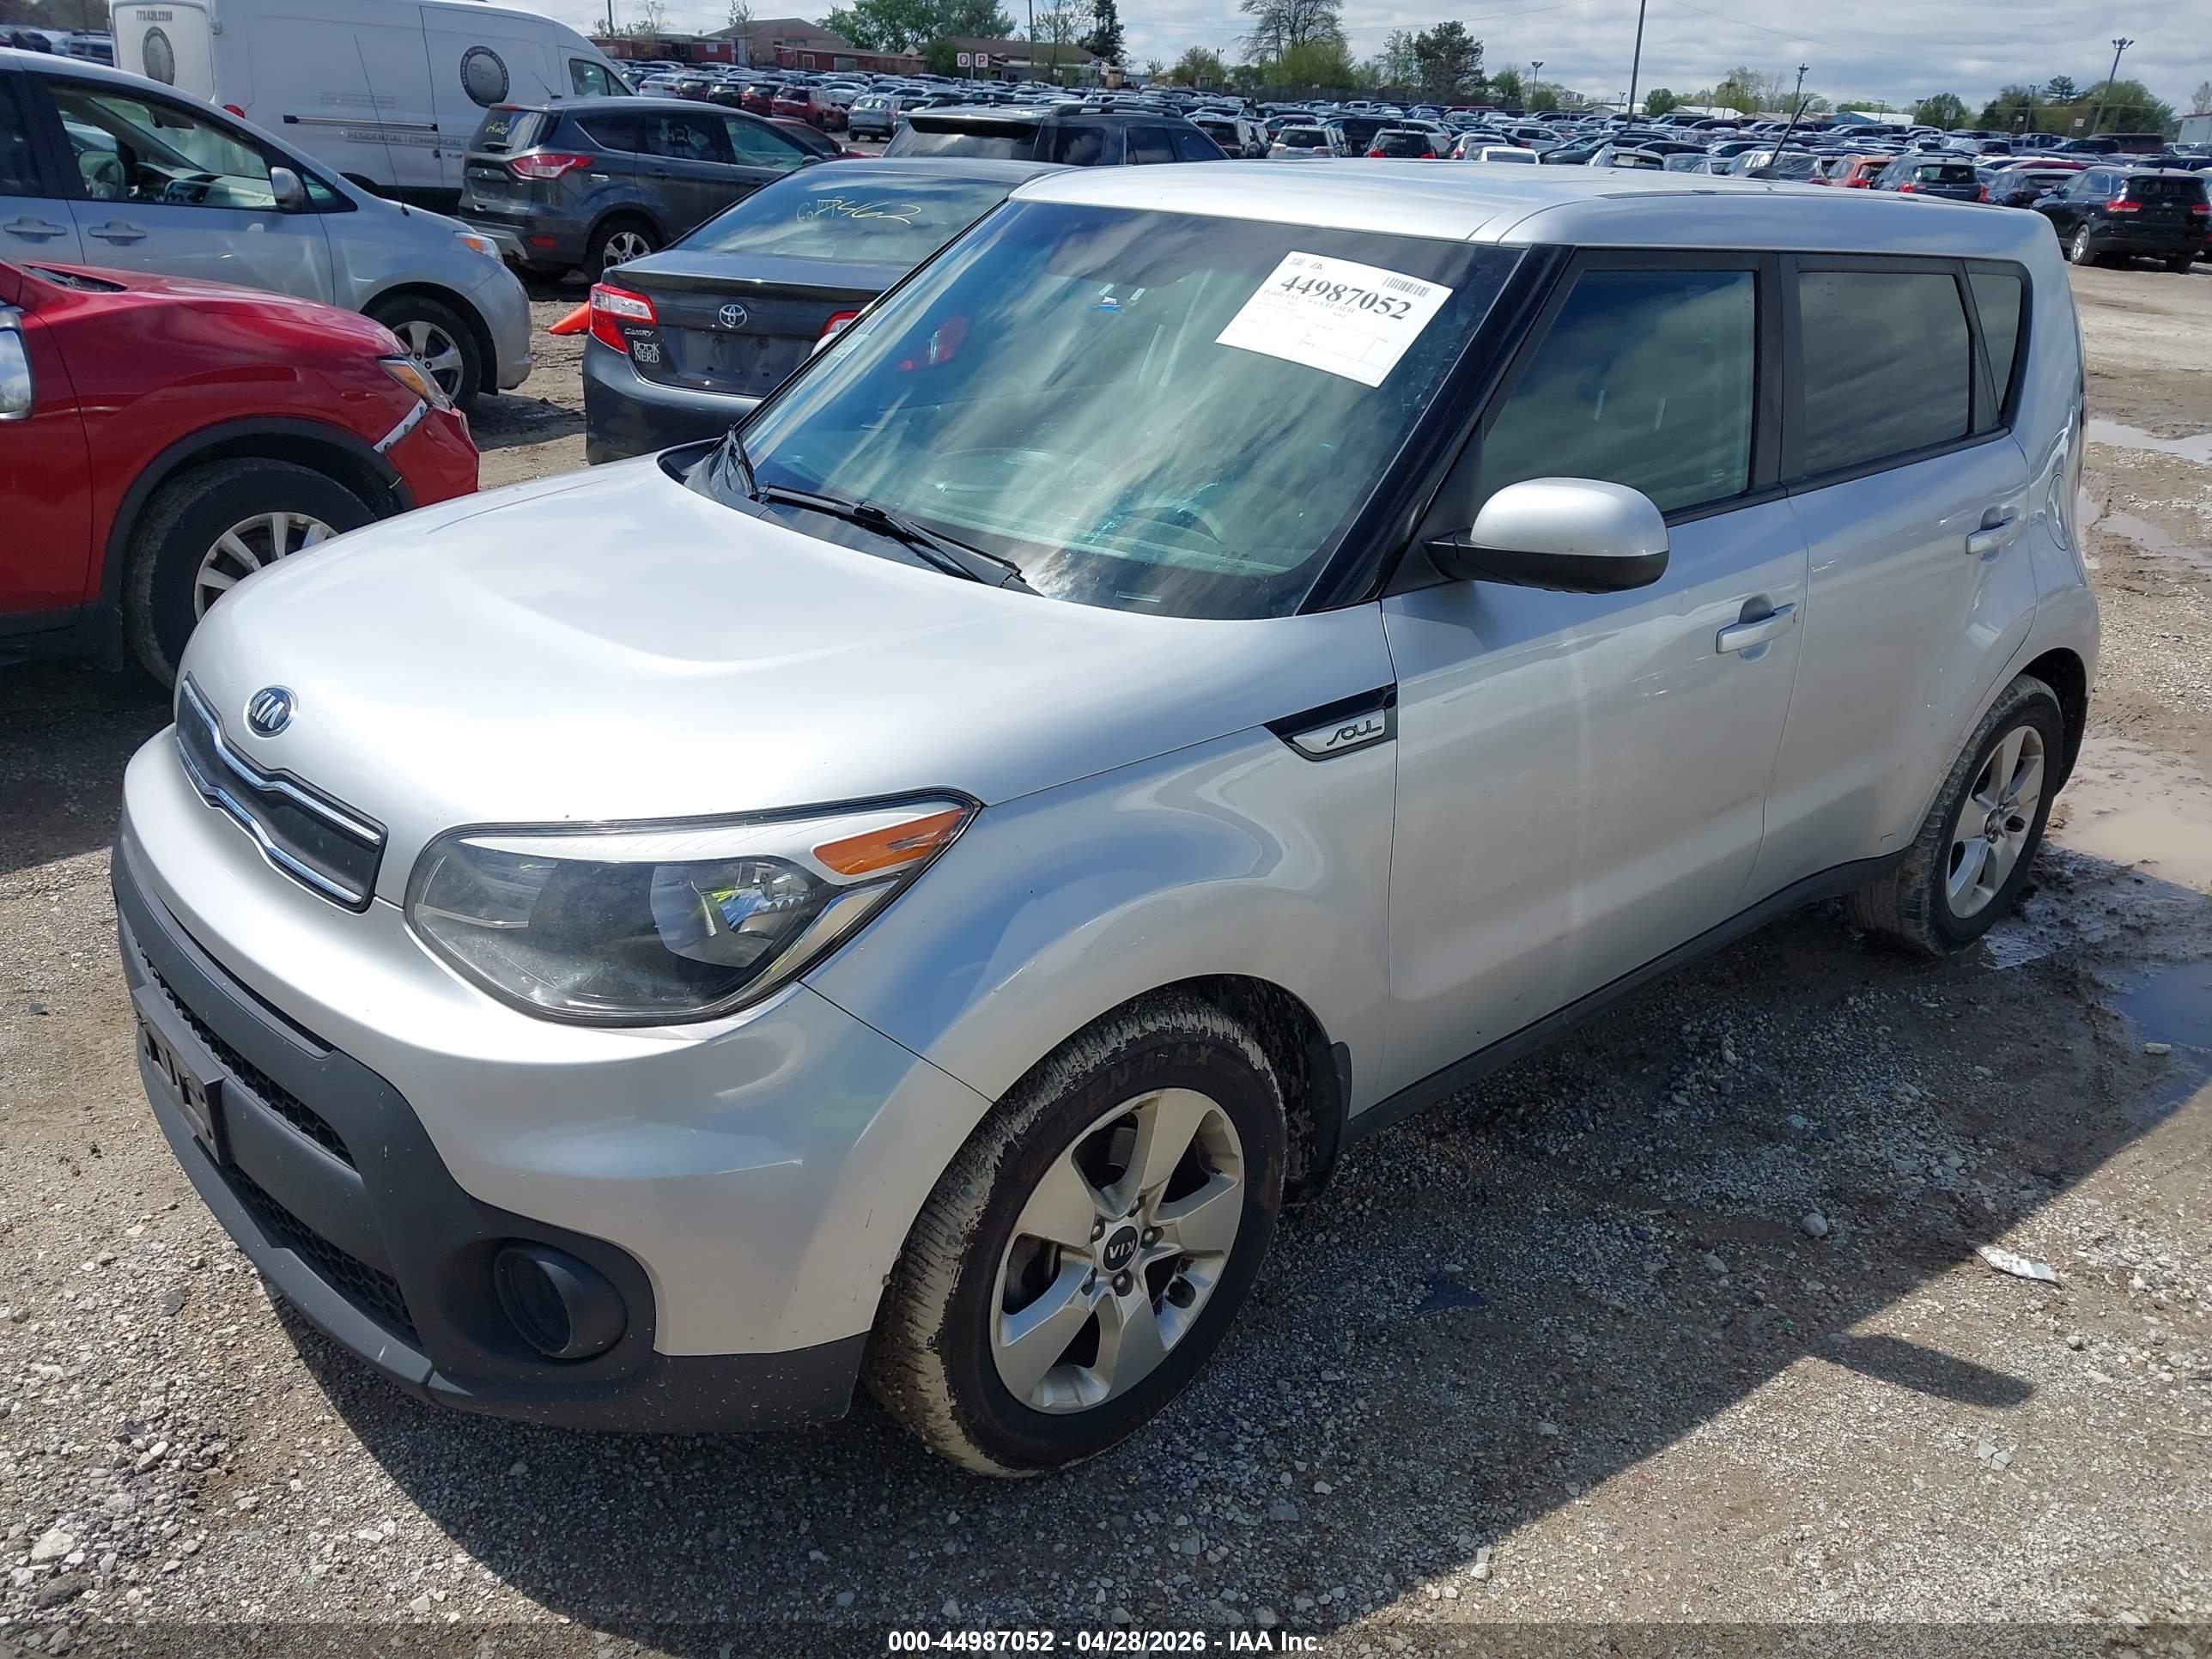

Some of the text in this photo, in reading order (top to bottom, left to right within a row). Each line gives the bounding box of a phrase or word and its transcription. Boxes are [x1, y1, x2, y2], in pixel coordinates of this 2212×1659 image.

[959, 54, 969, 65] Q
[978, 55, 986, 65] P
[347, 131, 462, 147] RESIDENTIAL COMMERCIAL
[1280, 276, 1412, 319] 44987052
[633, 340, 659, 354] BOOK
[635, 351, 659, 363] NERD
[1326, 720, 1382, 747] SOUL
[1109, 1239, 1136, 1260] KIA
